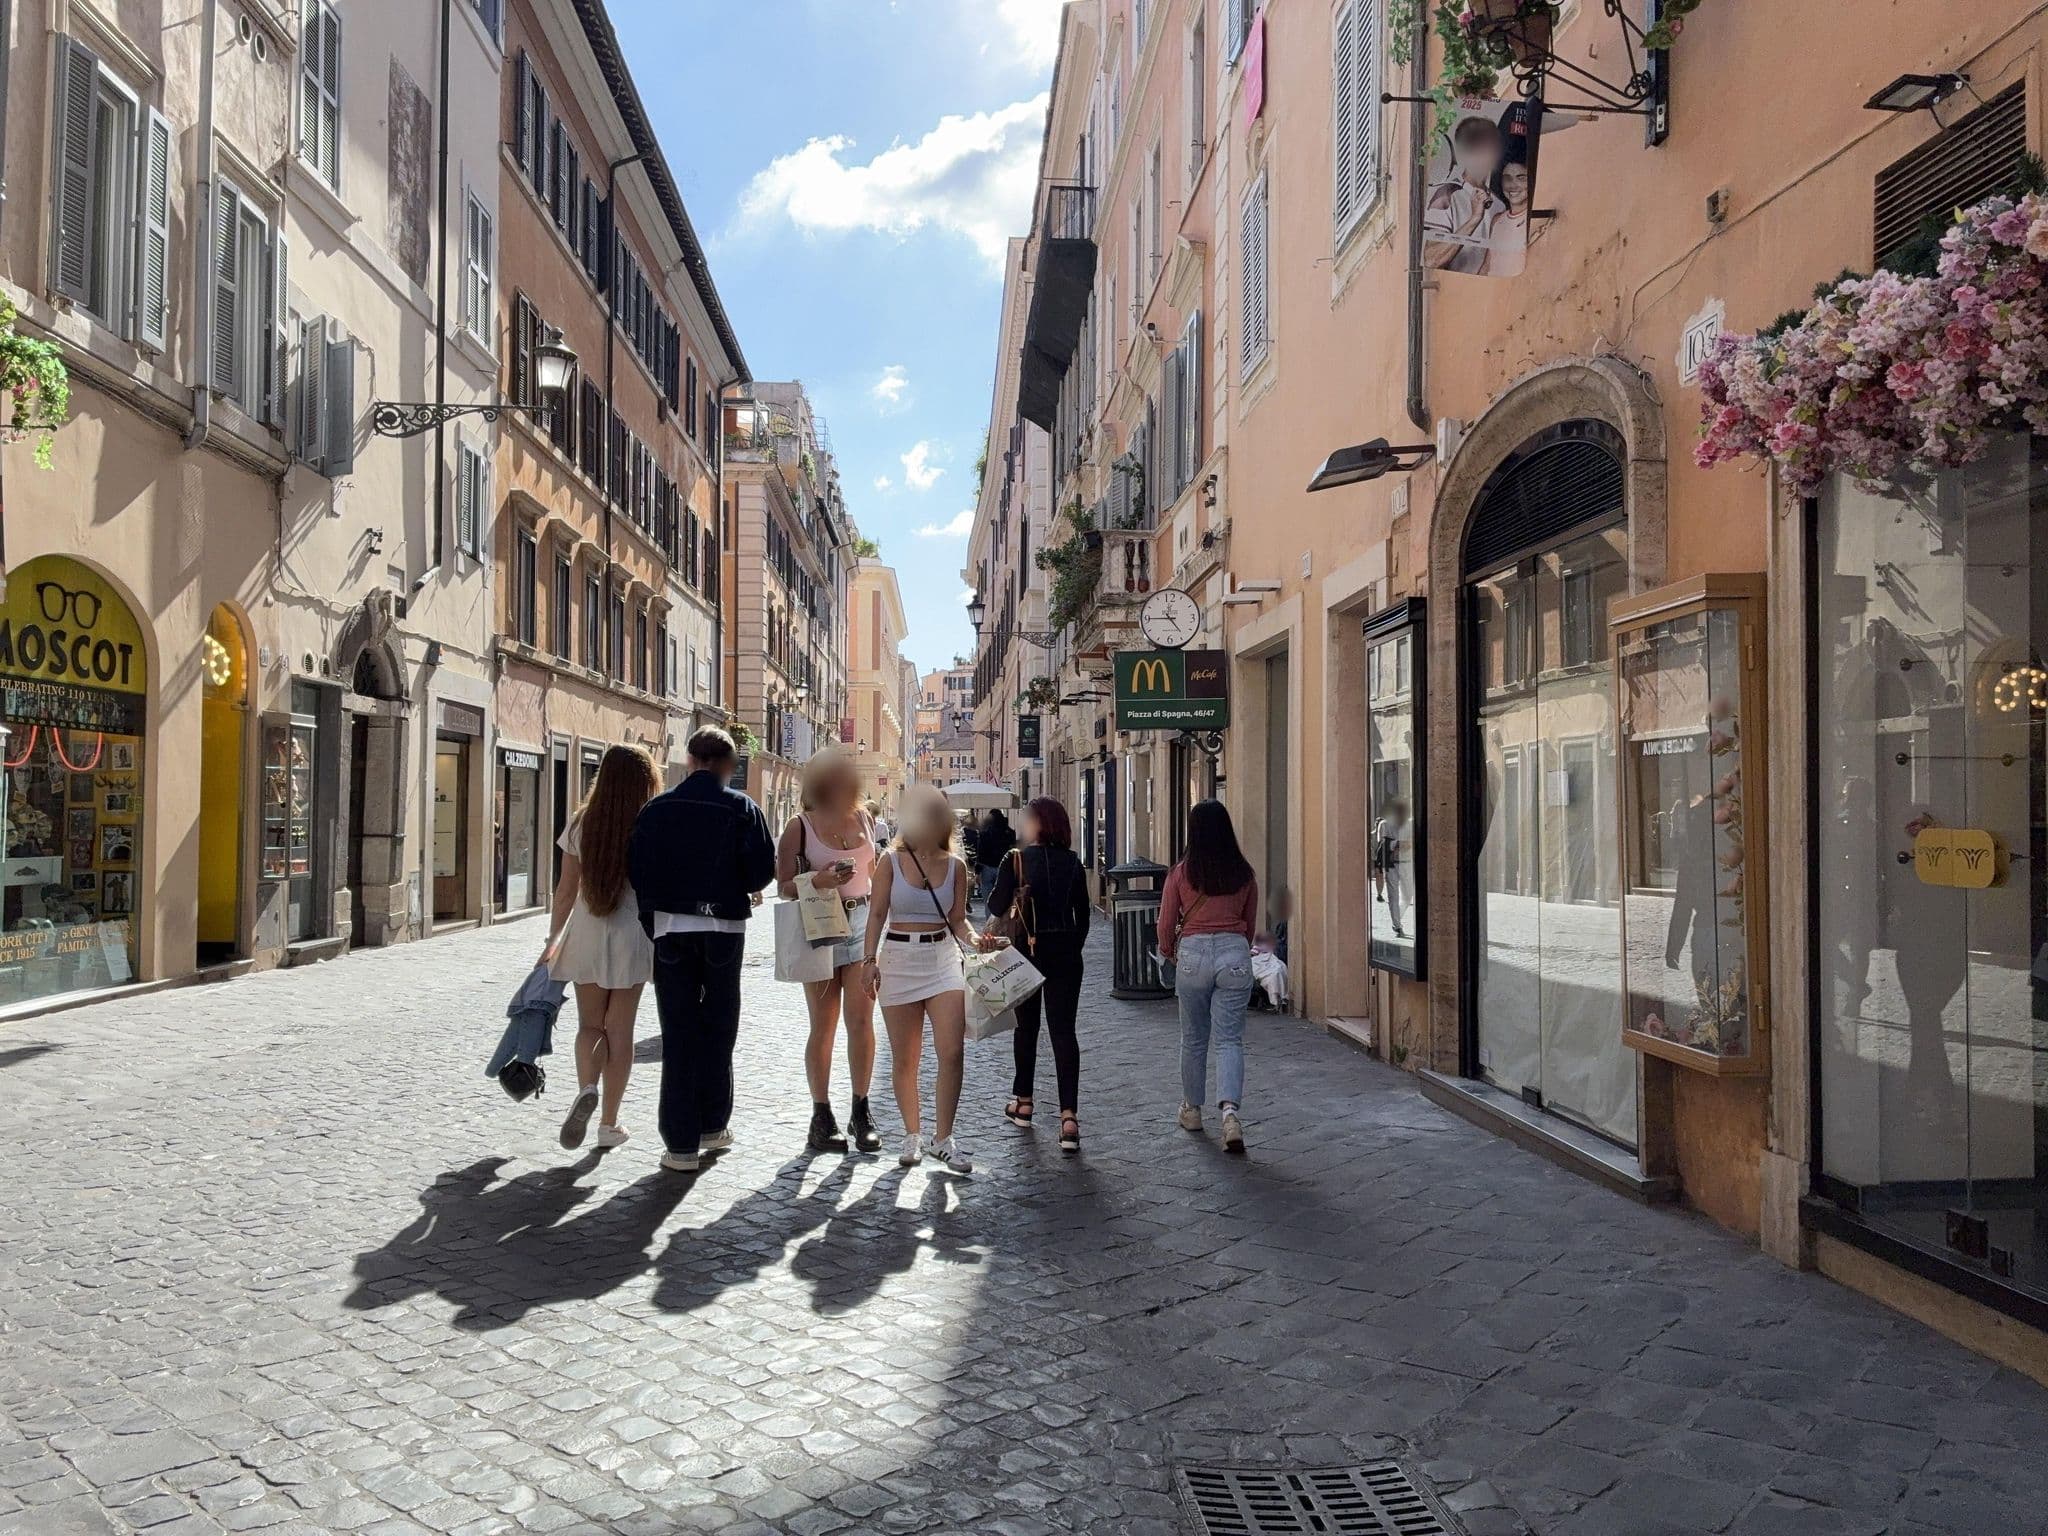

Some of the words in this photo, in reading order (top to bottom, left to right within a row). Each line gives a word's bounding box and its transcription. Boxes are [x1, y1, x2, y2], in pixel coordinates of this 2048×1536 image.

[1460, 99, 1482, 111] 2025
[1165, 593, 1176, 603] 12
[1144, 614, 1151, 624] 9
[1189, 613, 1196, 623] 3
[1166, 634, 1174, 645] 6
[0, 678, 65, 696] ELEBRATING
[1127, 710, 1152, 718] Piazza
[1153, 710, 1160, 718] di
[1161, 710, 1193, 719] Spagna,
[1193, 709, 1215, 717] 46/47
[0, 934, 23, 949] ORK
